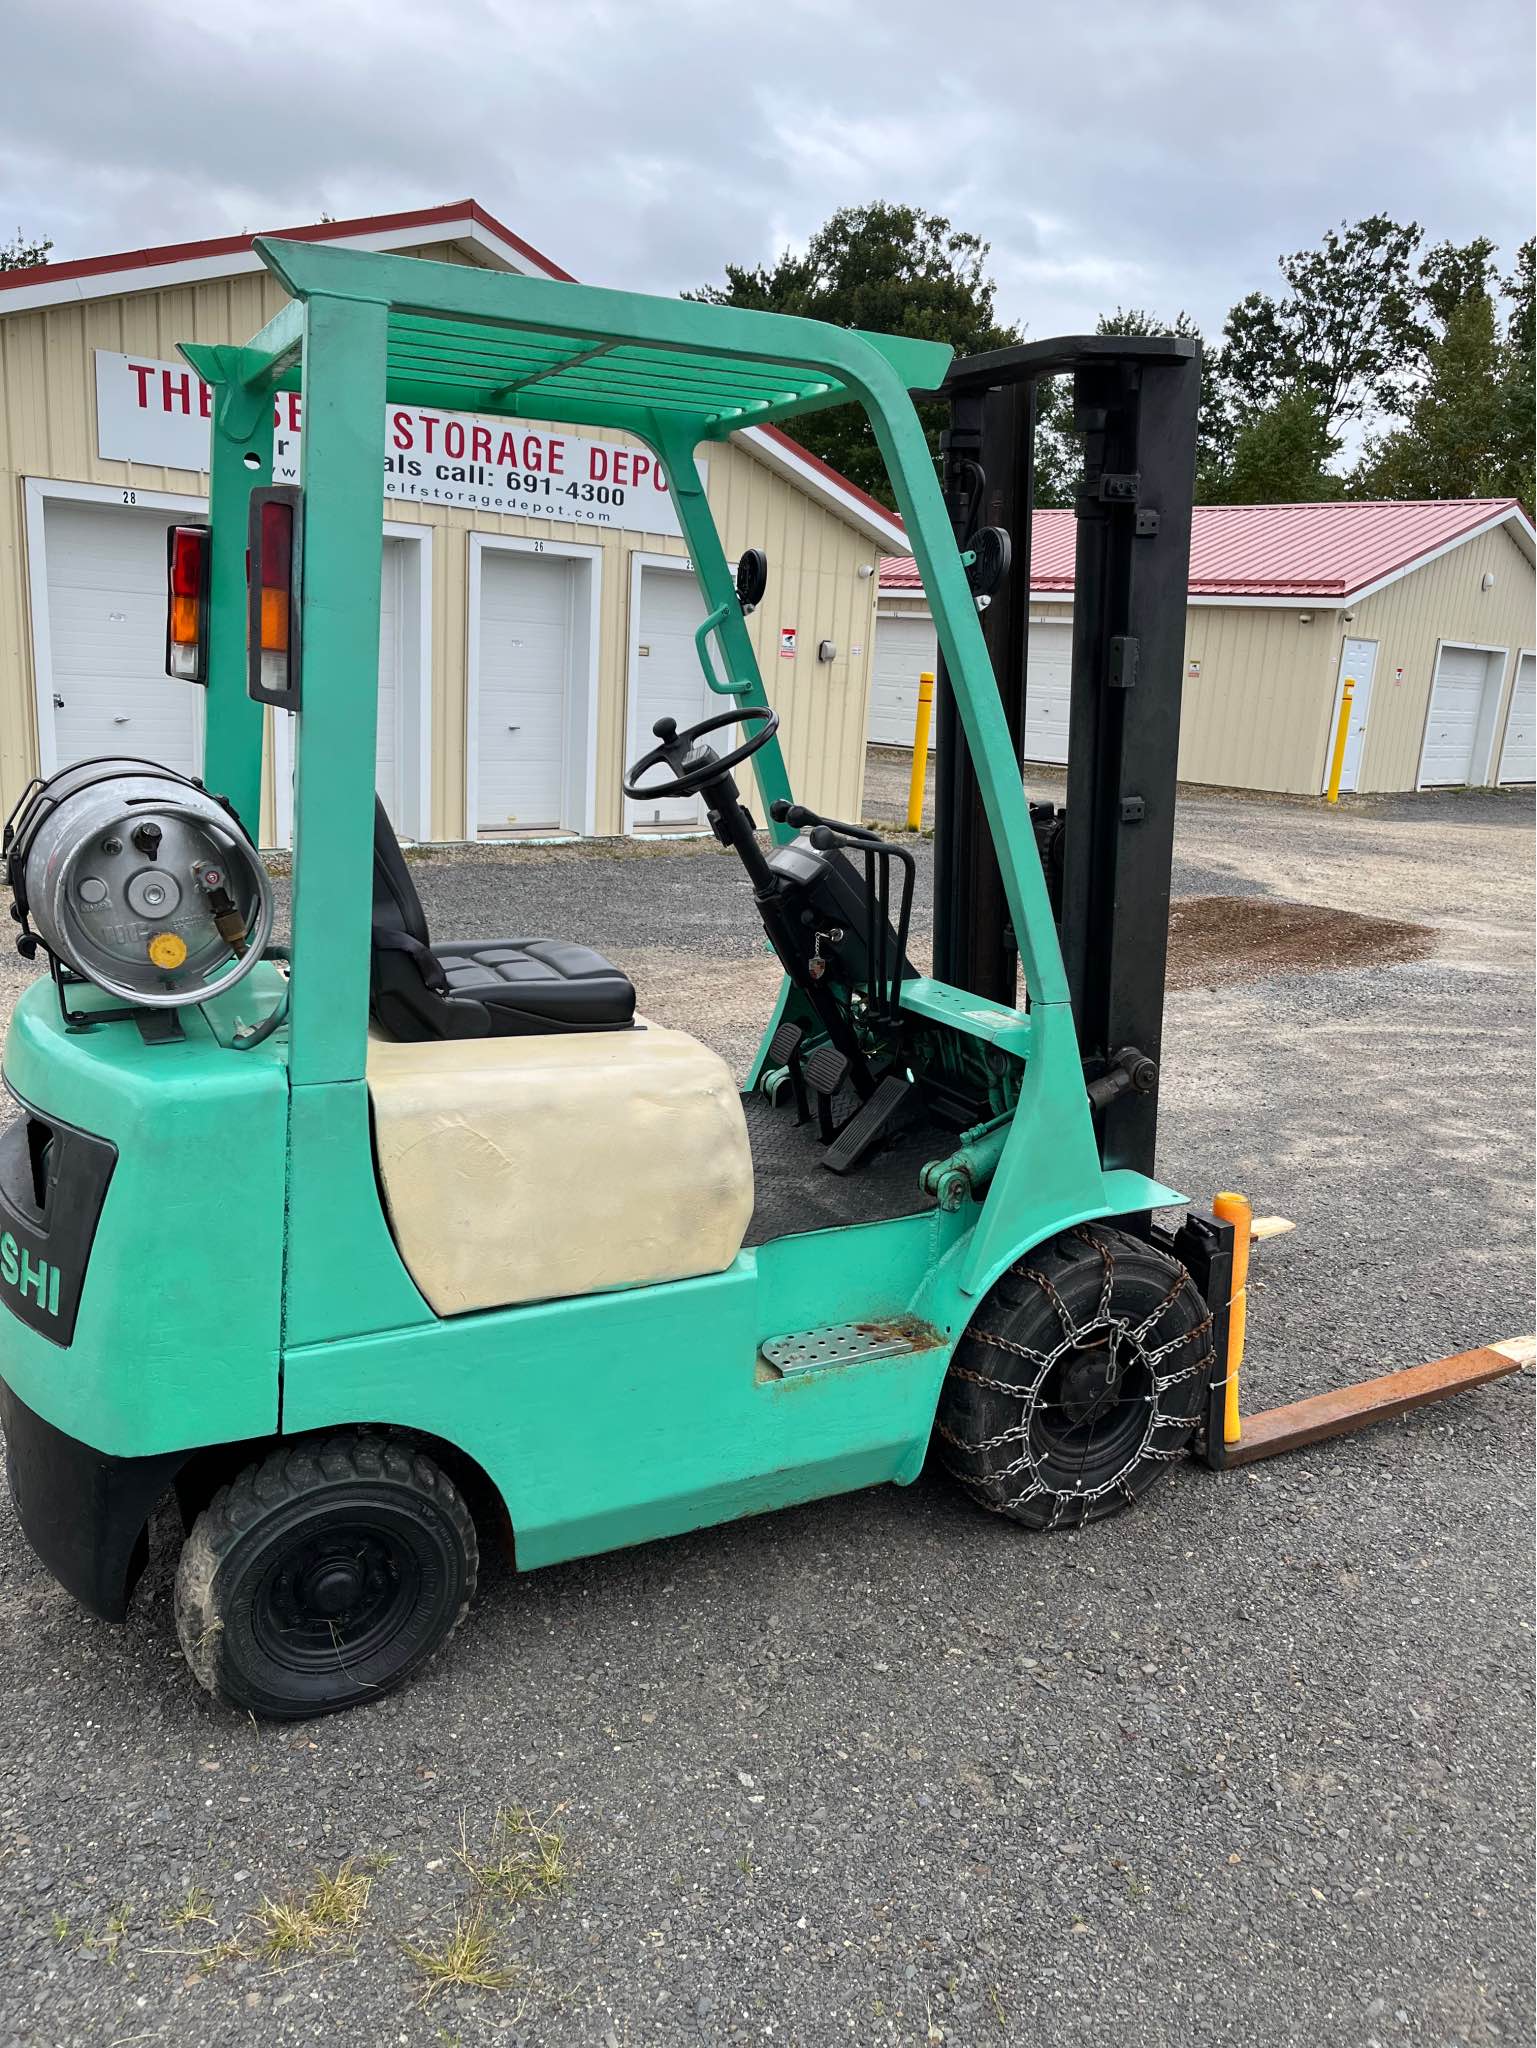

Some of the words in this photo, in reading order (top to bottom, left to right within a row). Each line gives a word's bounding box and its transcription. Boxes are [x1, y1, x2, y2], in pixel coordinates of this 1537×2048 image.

[393, 411, 565, 475] STORAGE
[123, 491, 136, 504] 28
[386, 482, 610, 521] elfstoragedepot.com
[436, 465, 493, 487] call:
[506, 472, 625, 506] 691-4300
[534, 541, 544, 551] 26
[1, 1231, 60, 1317] SHI
